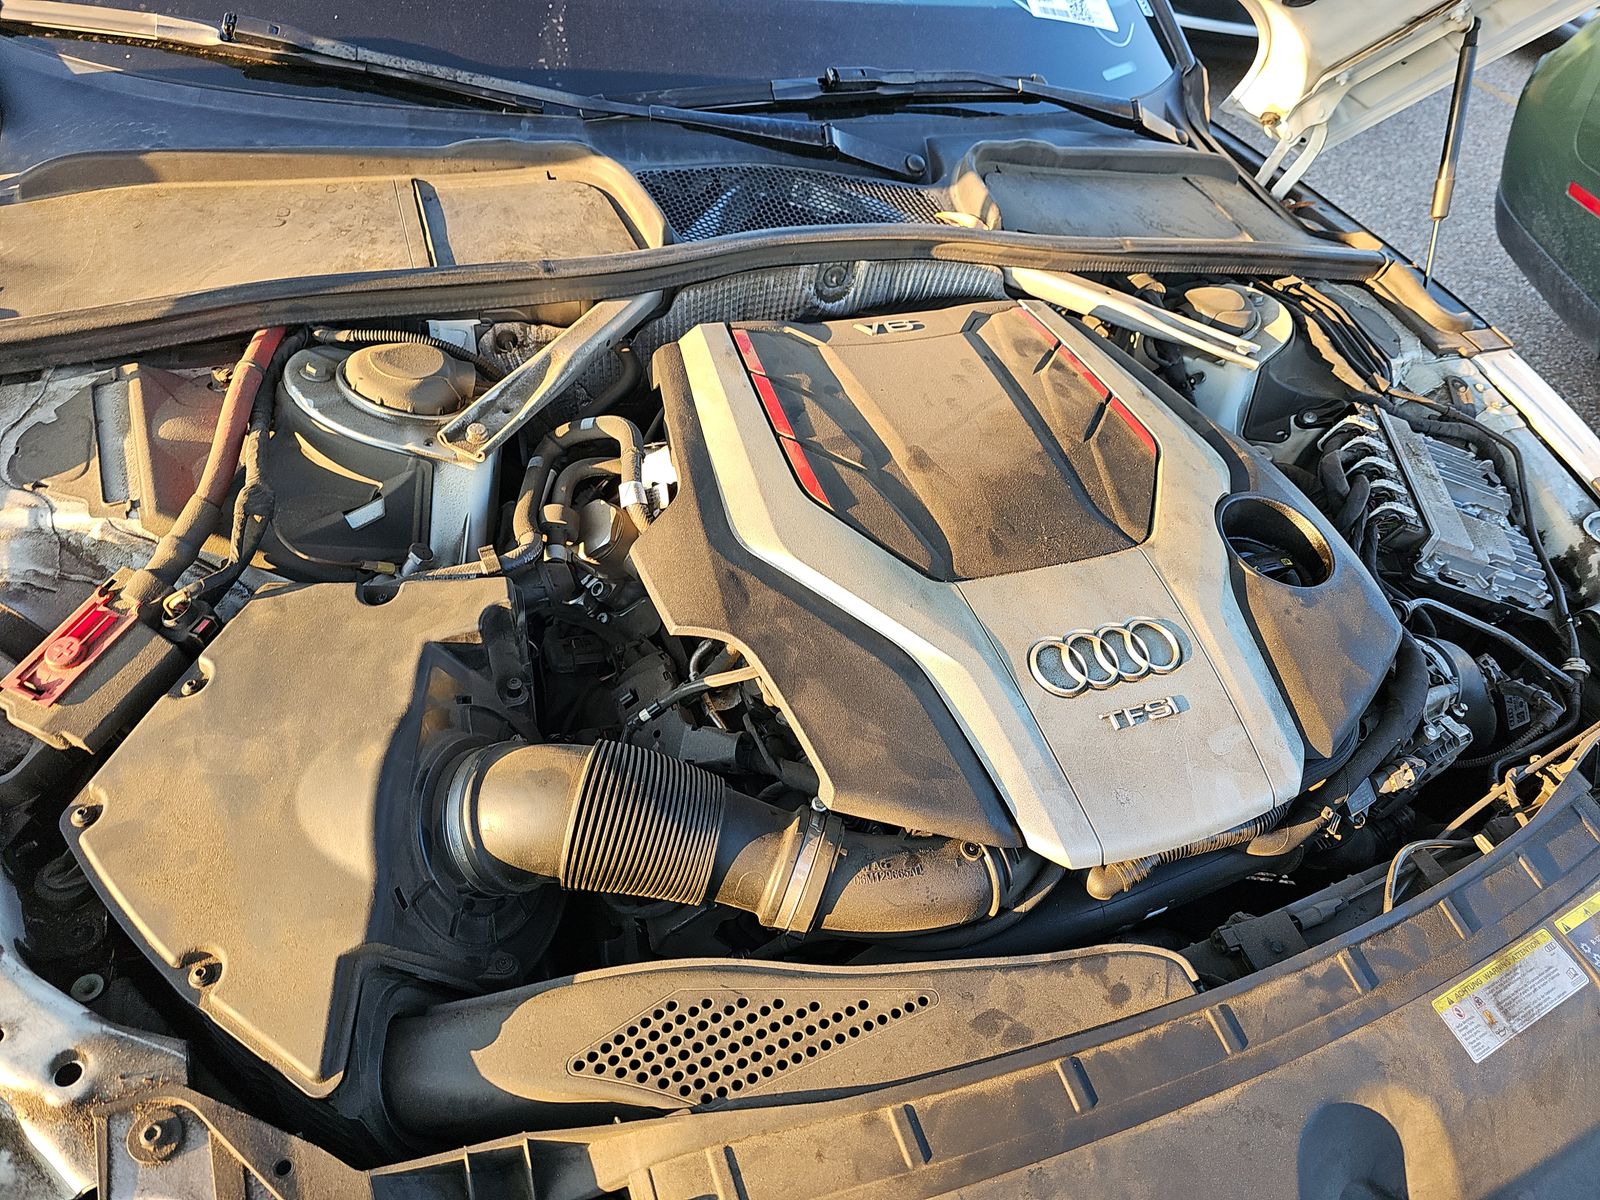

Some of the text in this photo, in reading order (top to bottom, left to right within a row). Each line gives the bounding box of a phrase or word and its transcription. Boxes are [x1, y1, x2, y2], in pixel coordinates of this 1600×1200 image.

[853, 320, 918, 336] V6
[1099, 696, 1180, 730] TFSI
[1454, 939, 1540, 1000] ACHTUNG WARNING ATTENTION
